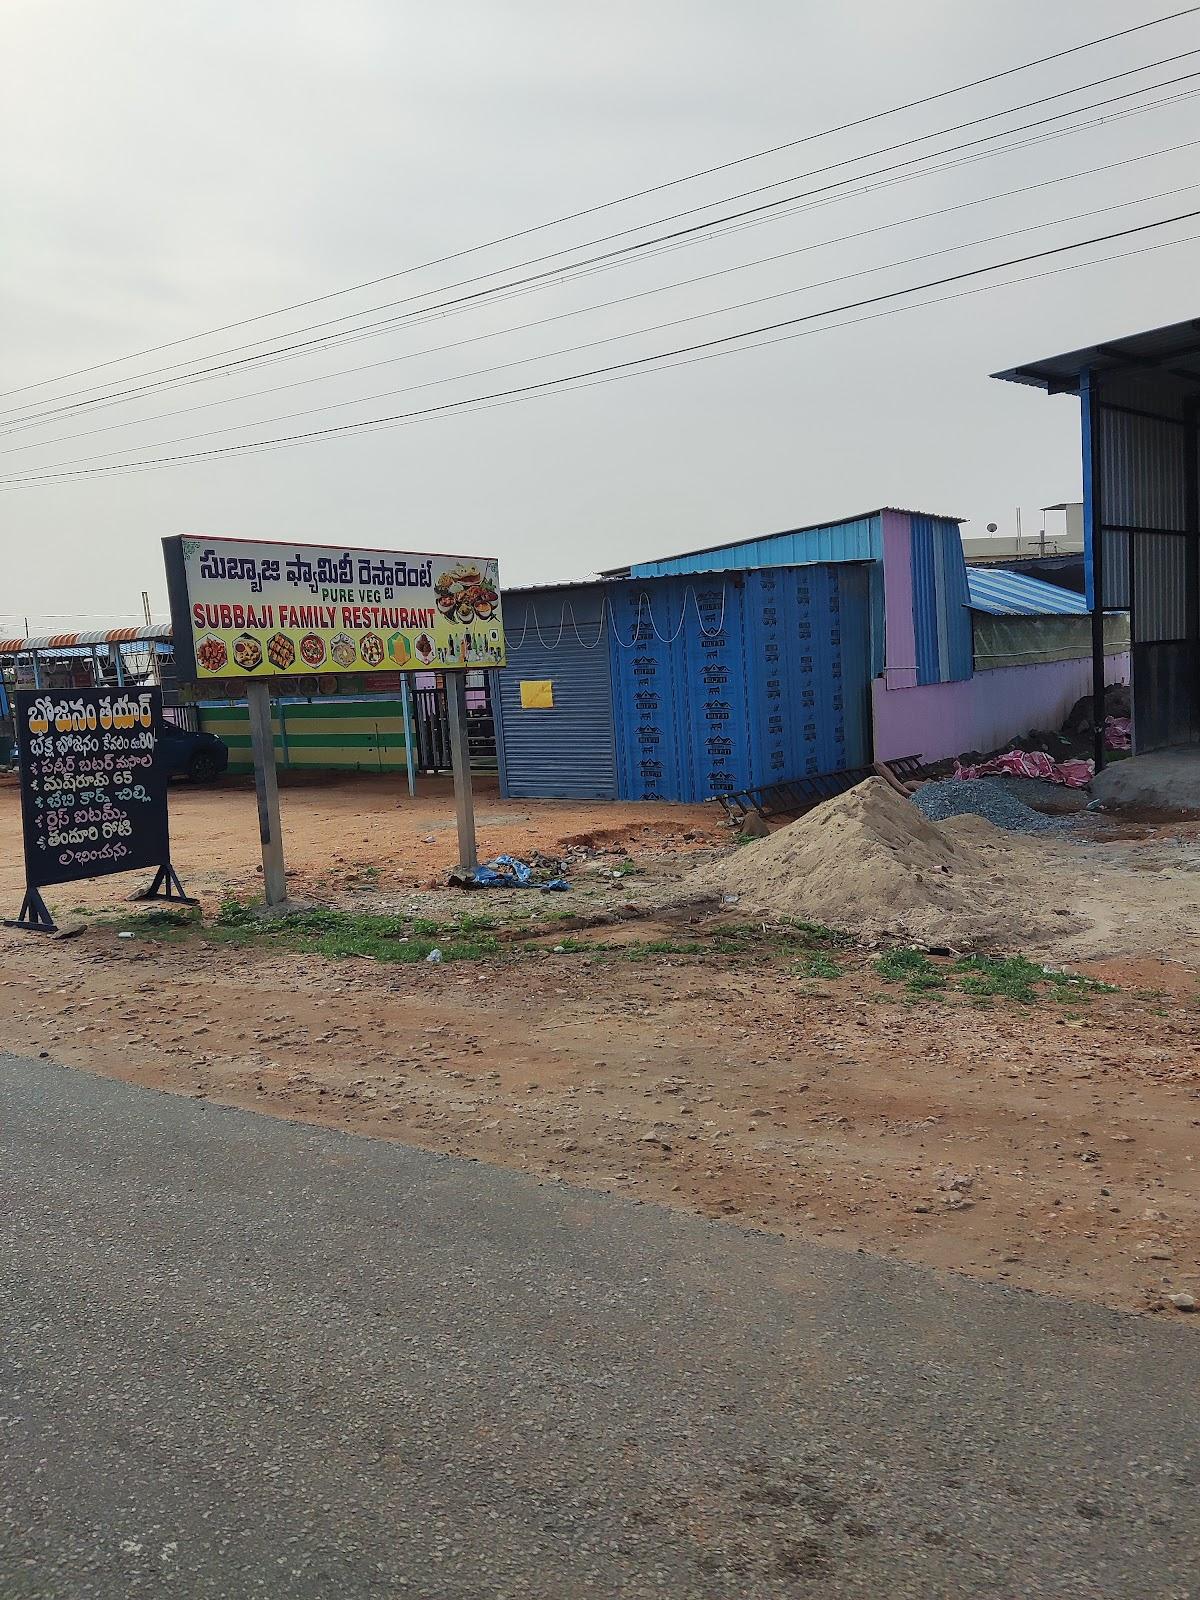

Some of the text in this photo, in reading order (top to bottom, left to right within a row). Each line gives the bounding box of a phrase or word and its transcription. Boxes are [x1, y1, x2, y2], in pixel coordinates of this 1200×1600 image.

[200, 549, 281, 593] సుబ్బాజి
[357, 559, 433, 600] రెస్టారెంట్
[321, 587, 382, 604] PURE VEG
[192, 603, 436, 630] SUBBAJI FAMILY RESTAURANT
[99, 693, 152, 730] తయార్
[102, 732, 130, 751] కేవలం
[78, 753, 115, 772] బటర్
[112, 770, 133, 785] 65
[46, 807, 70, 832] రైస్
[47, 826, 99, 847] తందూరి
